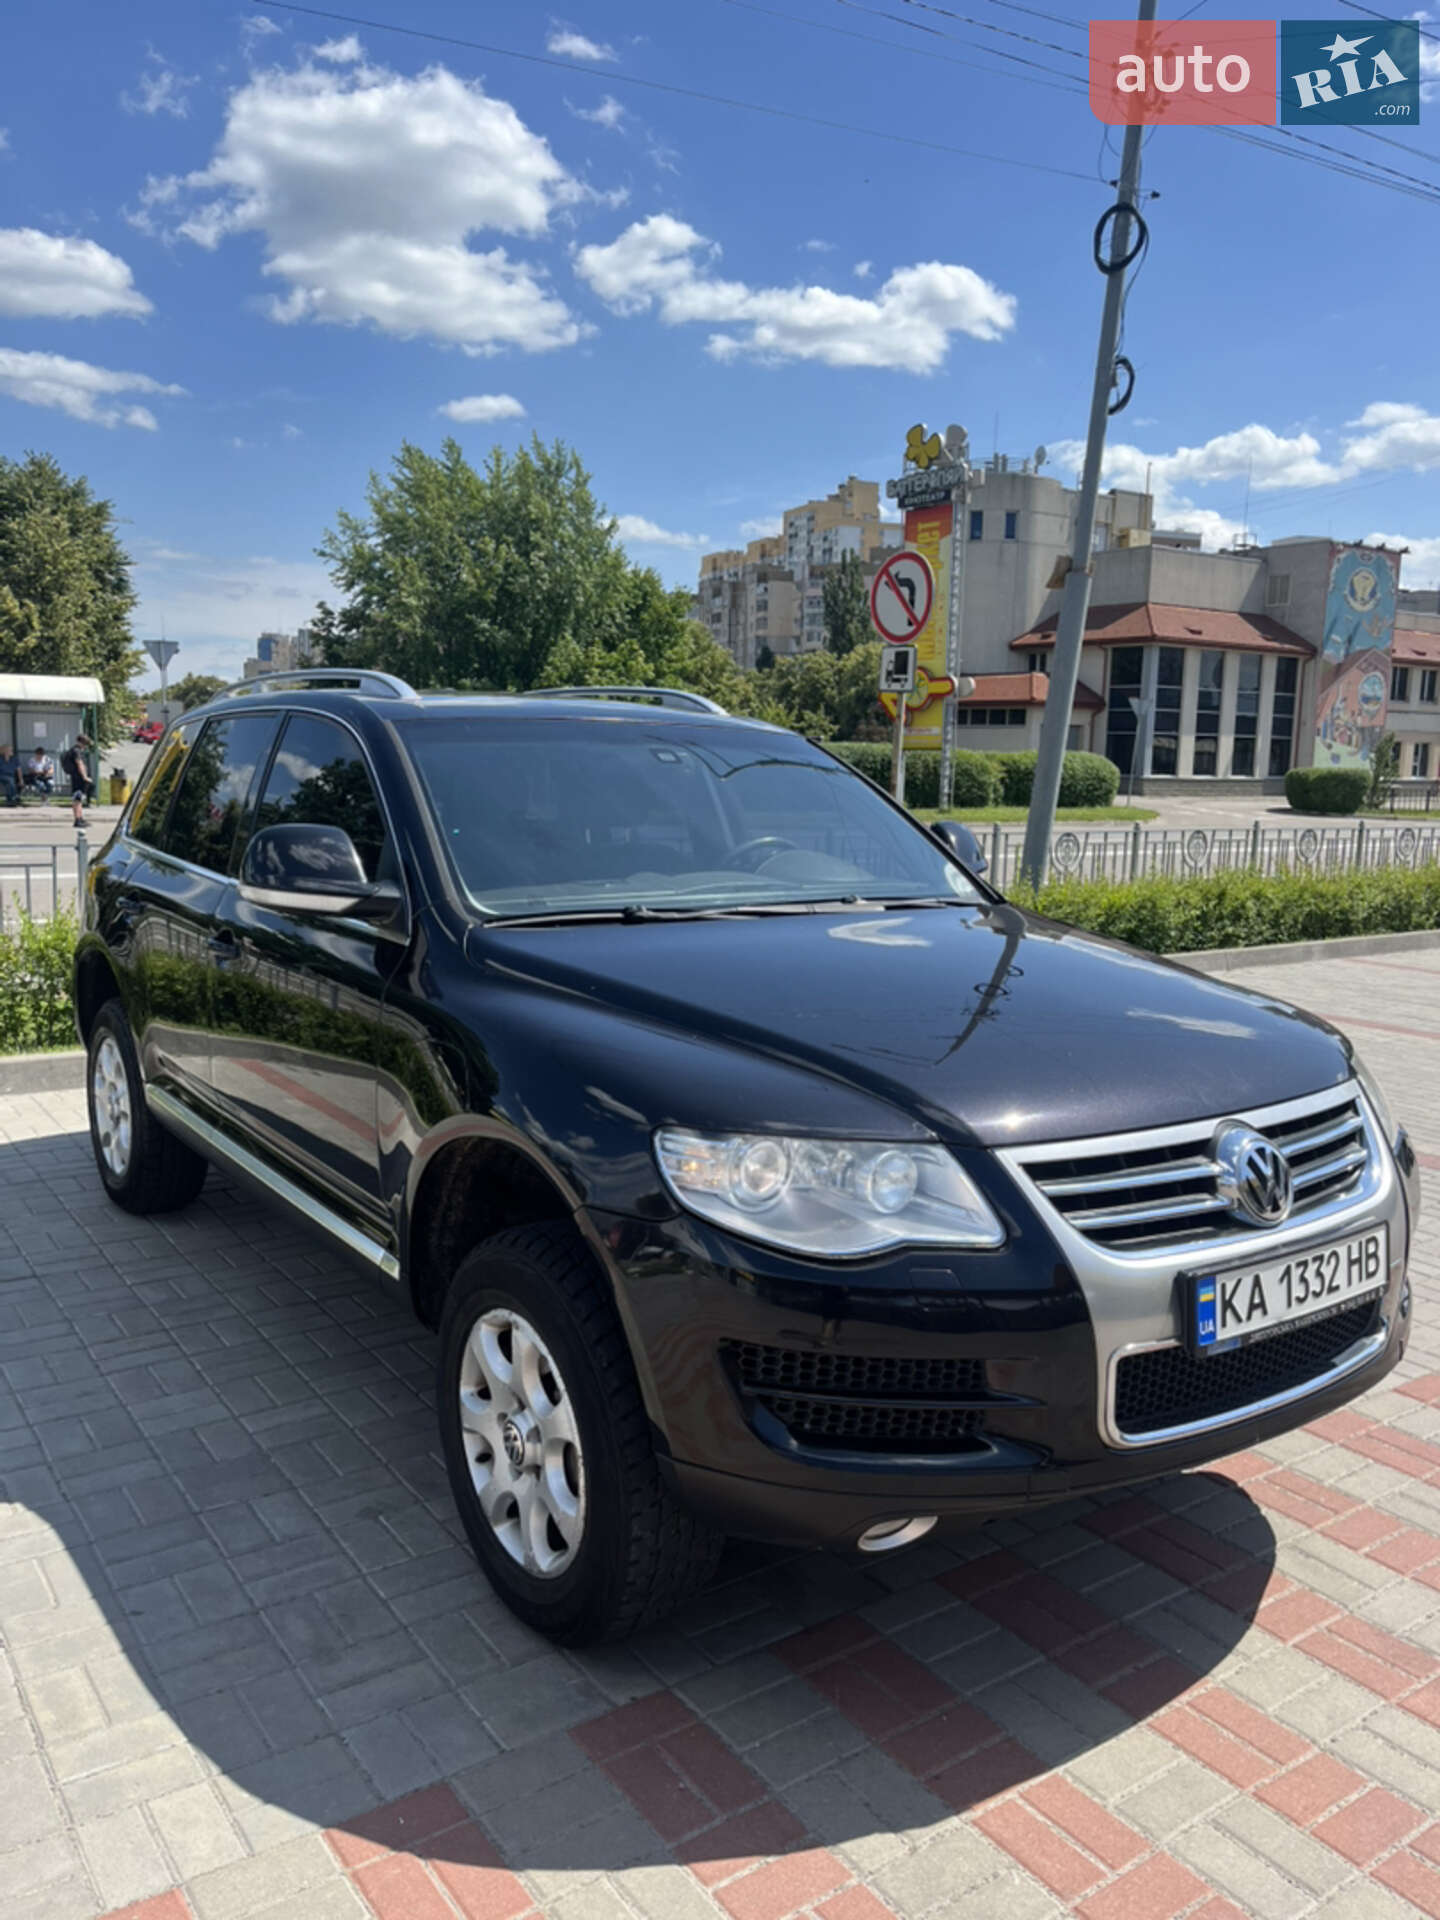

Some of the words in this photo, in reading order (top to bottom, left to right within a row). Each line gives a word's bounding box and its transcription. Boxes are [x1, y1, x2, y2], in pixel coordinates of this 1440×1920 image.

[1221, 1273, 1268, 1328] KA
[1280, 1250, 1341, 1309] 1332
[1346, 1236, 1381, 1287] HB
[1199, 1320, 1215, 1336] UA
